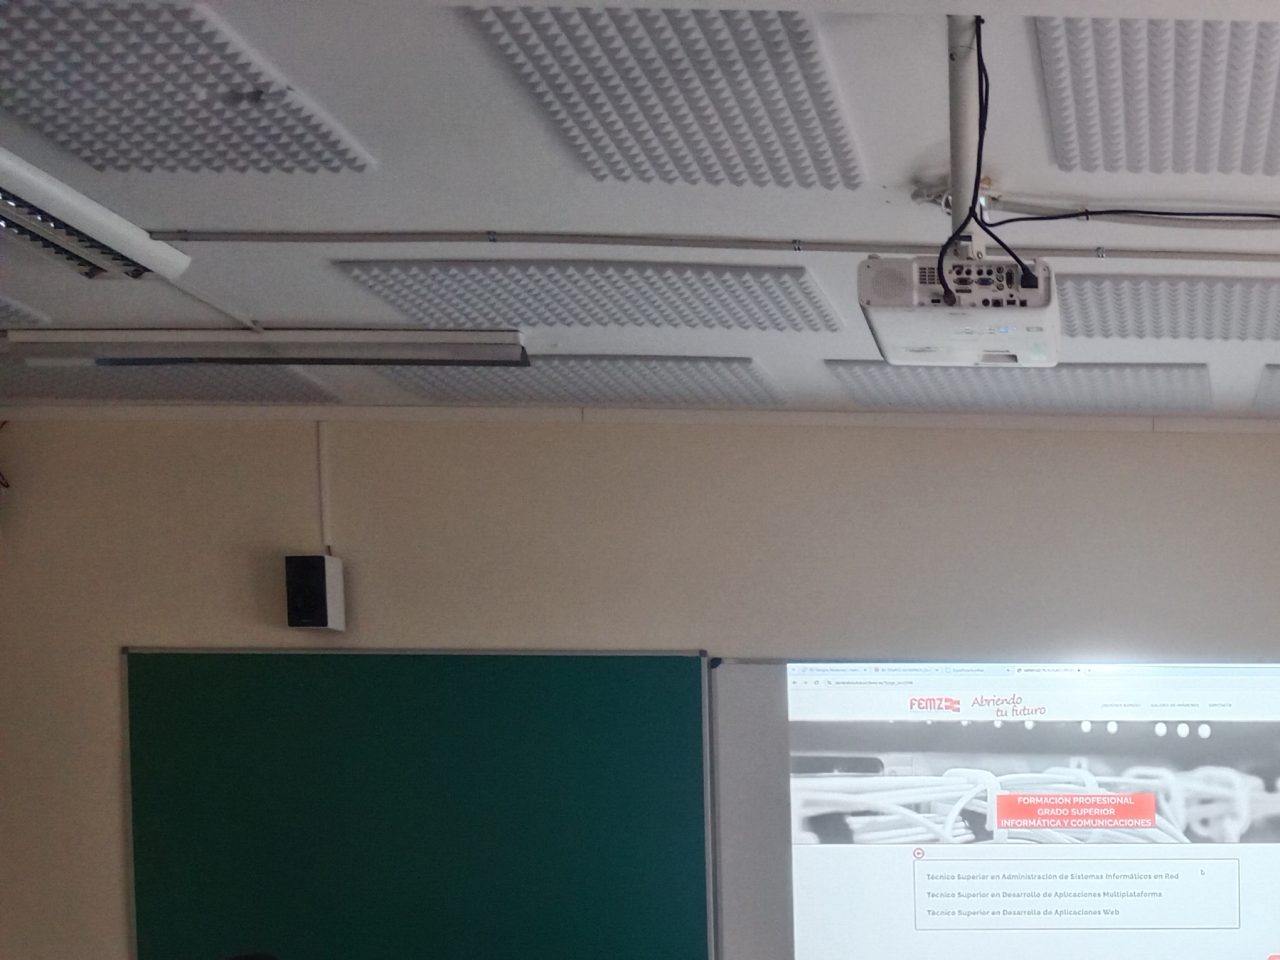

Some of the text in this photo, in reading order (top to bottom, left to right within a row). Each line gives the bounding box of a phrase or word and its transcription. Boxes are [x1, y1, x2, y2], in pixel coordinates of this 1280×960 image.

[909, 697, 944, 710] FEMZ
[971, 693, 1023, 707] Abriendo
[996, 705, 1047, 717] tu futuro
[1017, 796, 1135, 805] FORMACIÓN PROFESIONAL
[1037, 808, 1115, 816] GRADO SUPERIOR
[1001, 818, 1152, 827] INFORMÁTICA Y COMUNICACIONES
[957, 873, 989, 882] Superior
[957, 891, 989, 900] Superior
[1053, 891, 1101, 899] Aplicaciones
[1103, 891, 1162, 899] Multiplataforma
[958, 909, 989, 917] Superior
[1054, 909, 1101, 917] Aplicaciones
